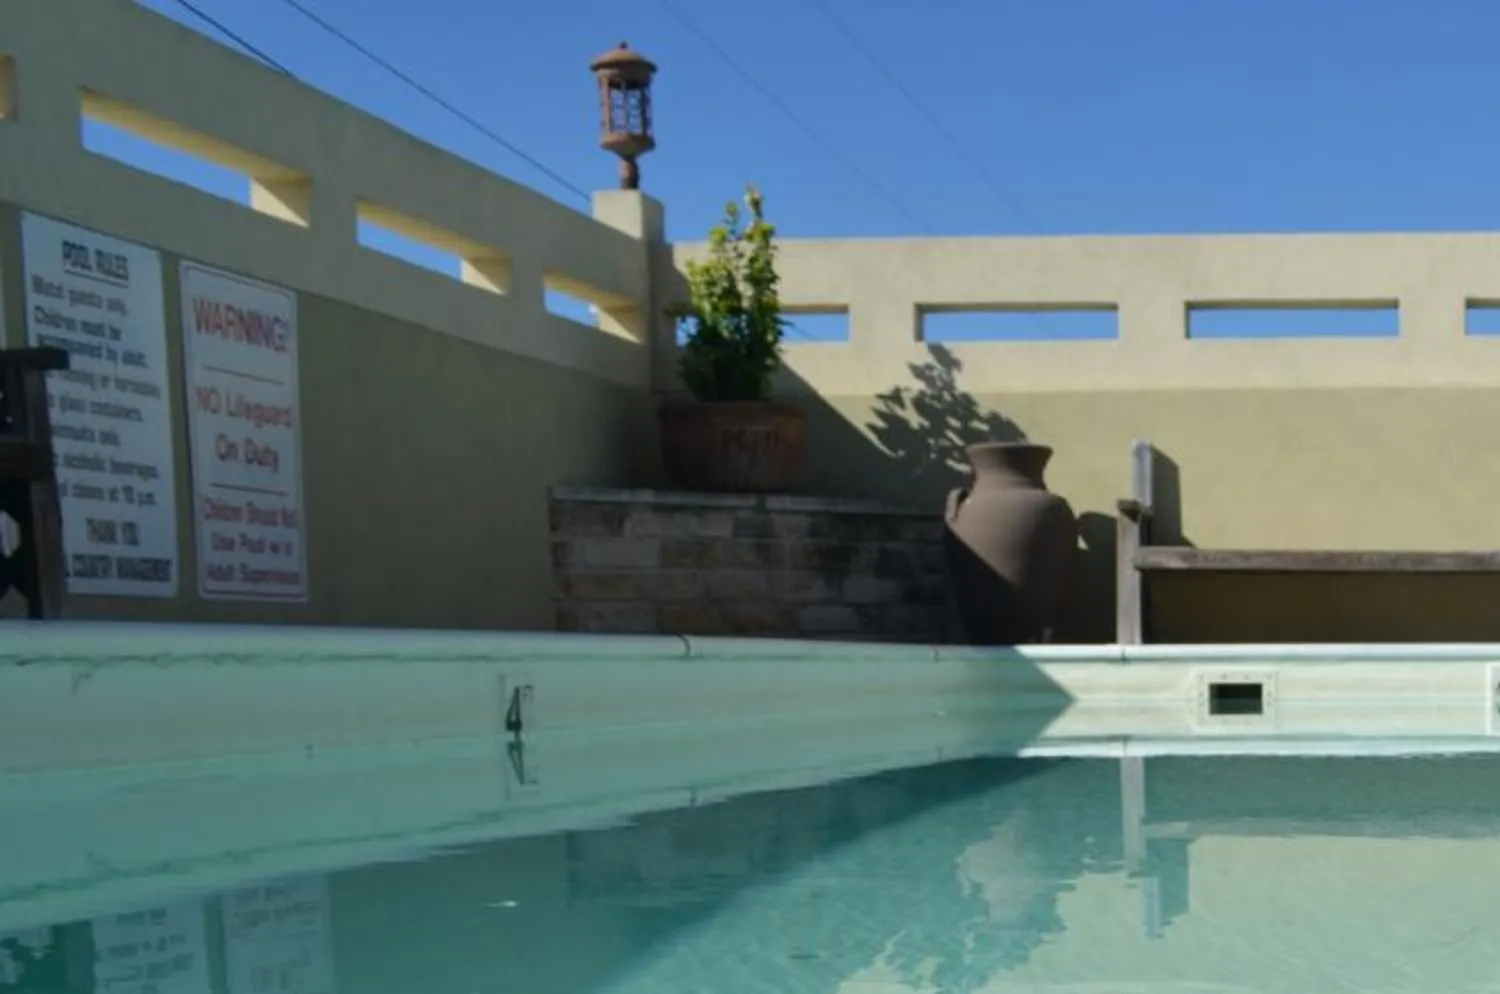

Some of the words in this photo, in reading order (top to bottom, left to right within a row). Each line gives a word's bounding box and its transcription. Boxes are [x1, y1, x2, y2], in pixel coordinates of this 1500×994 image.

[62, 240, 93, 273] POOL
[94, 249, 129, 281] RULES
[192, 298, 290, 352] WARNING!
[196, 386, 221, 414] NO
[226, 391, 293, 428] Lifeguard
[214, 432, 238, 461] On
[245, 436, 280, 473] Duty
[239, 532, 266, 554] Pool
[505, 685, 523, 737] 4
